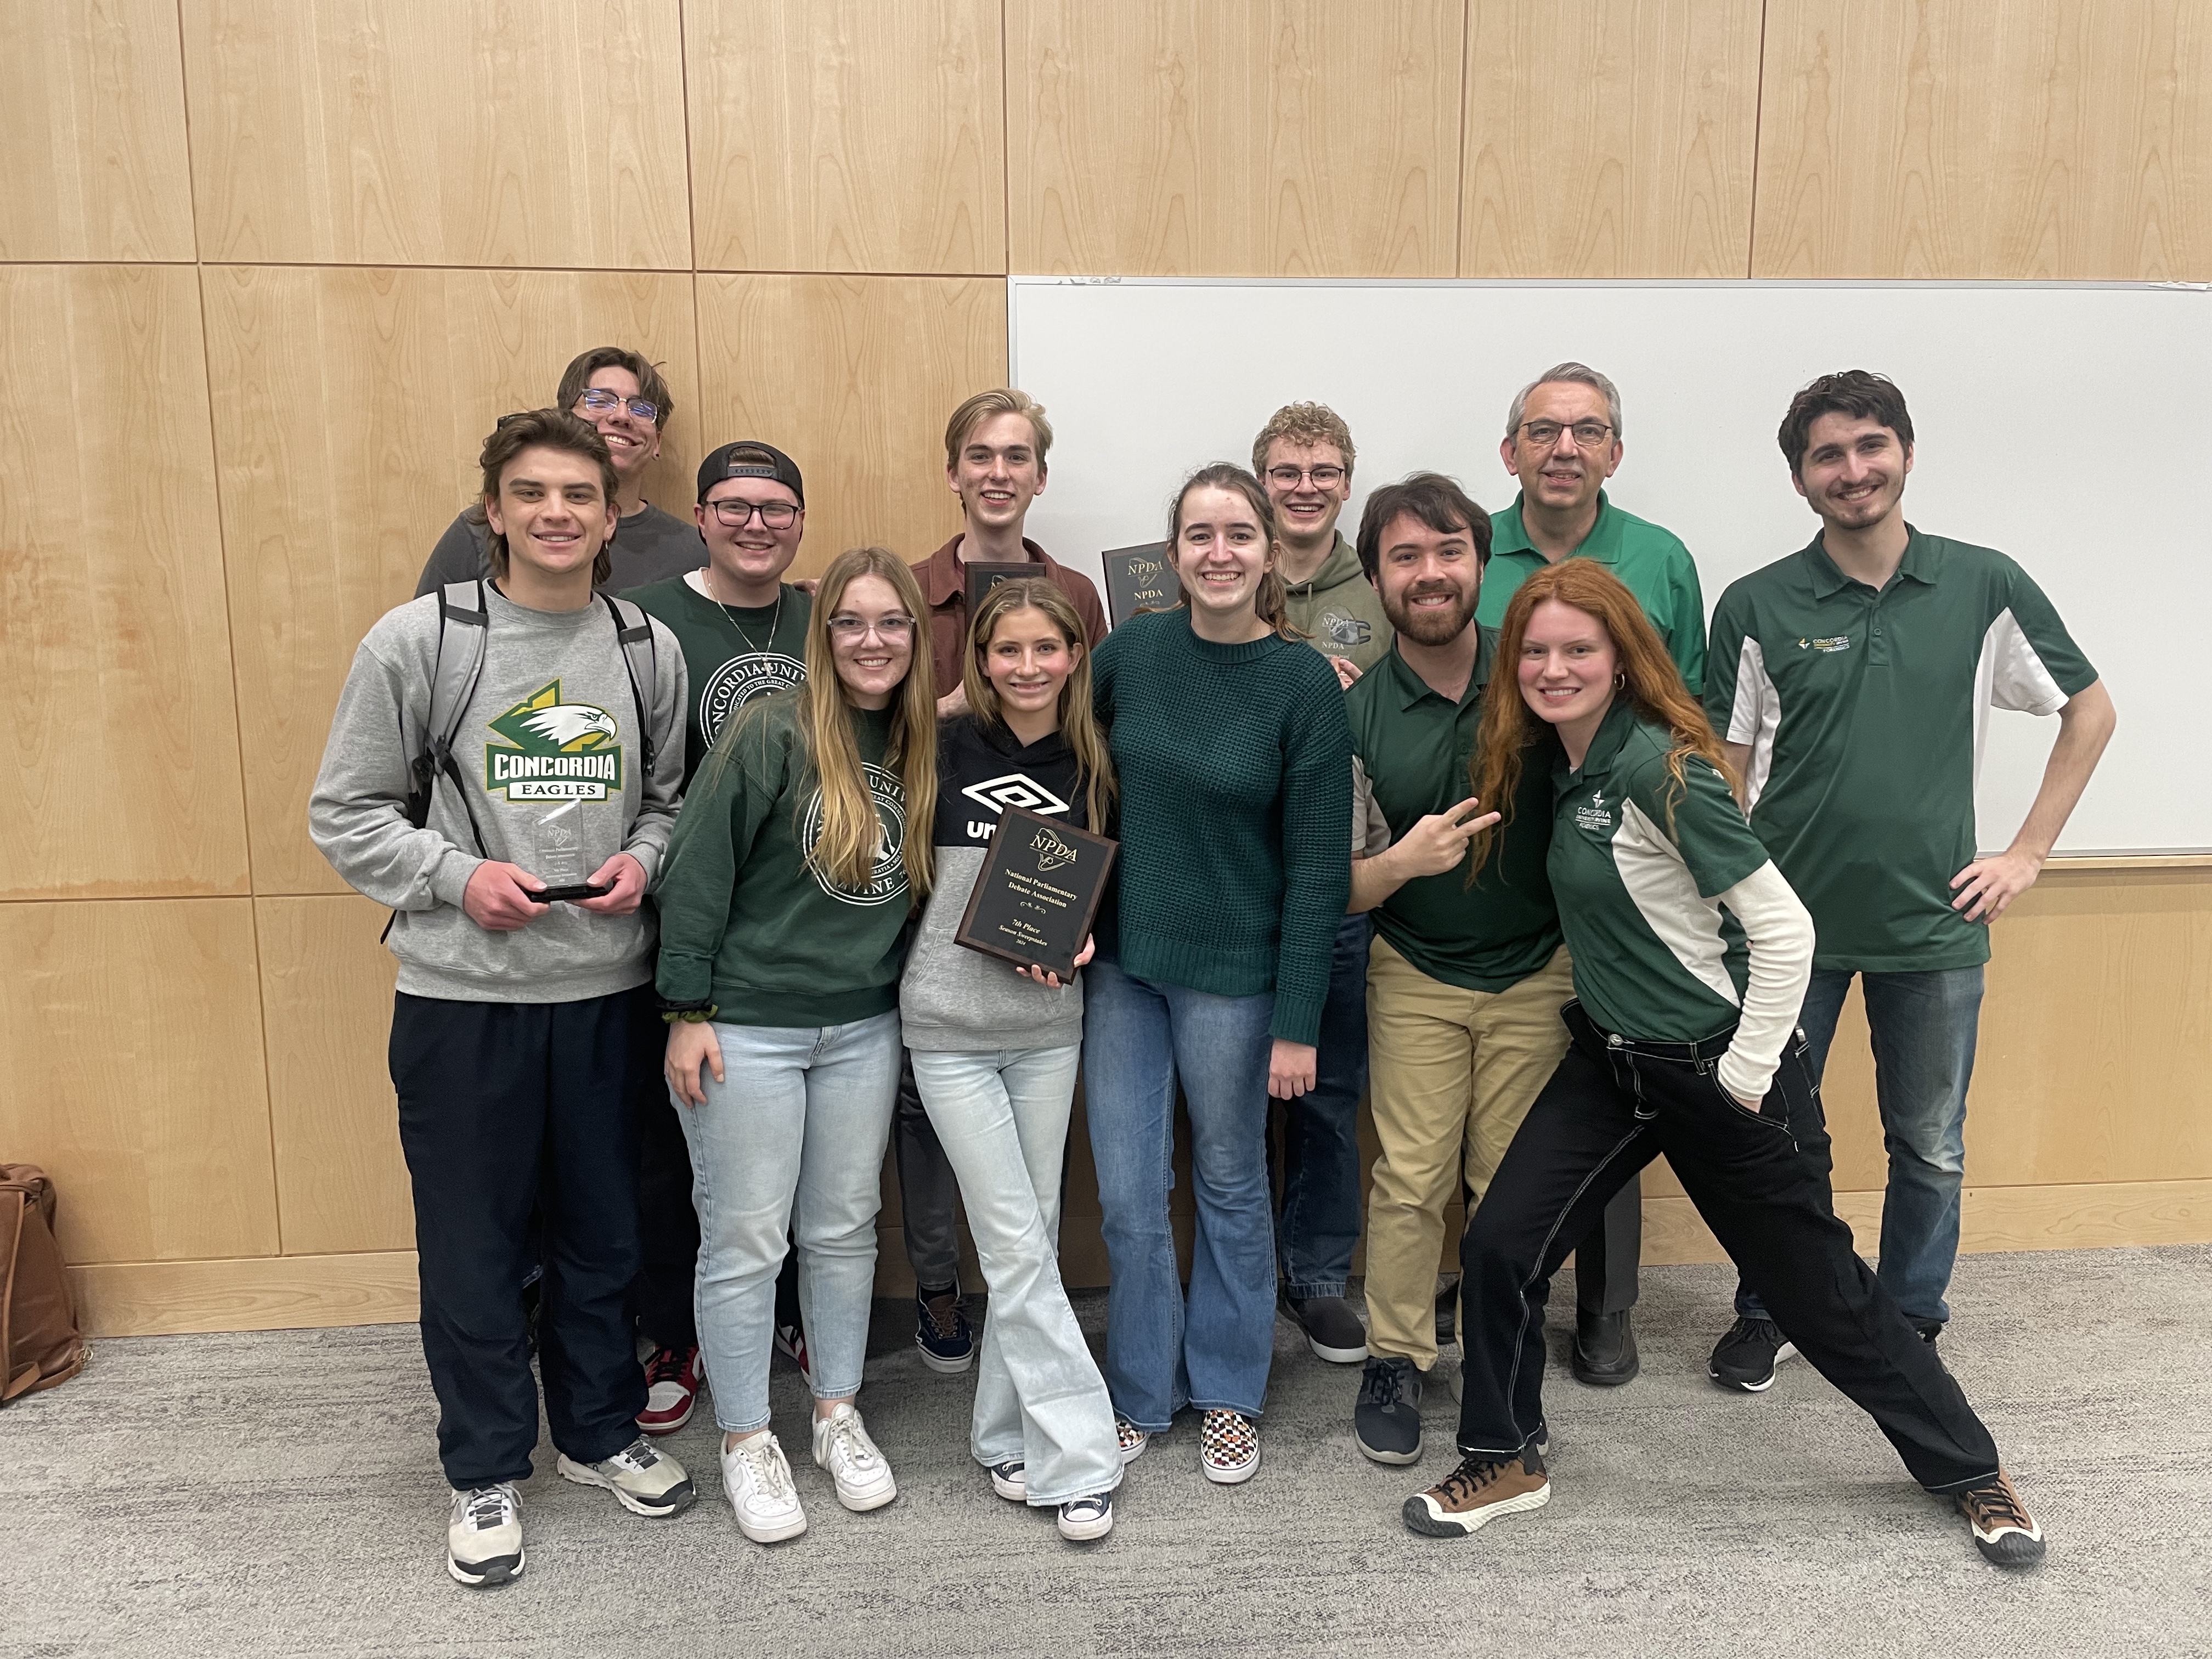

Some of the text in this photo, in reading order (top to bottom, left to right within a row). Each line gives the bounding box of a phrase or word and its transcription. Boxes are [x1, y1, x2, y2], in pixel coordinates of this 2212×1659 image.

[1127, 561, 1163, 575] NPDA
[1134, 589, 1163, 601] NPDA
[1322, 618, 1348, 627] NPDA
[1322, 641, 1344, 650] NPDA
[494, 753, 616, 781] CONCORDIA
[521, 784, 596, 795] EAGLES
[1030, 834, 1078, 862] NPDA
[1005, 868, 1078, 901] National Parliamentary
[1008, 881, 1067, 908] Debate Association
[1012, 919, 1041, 934] 7th Place
